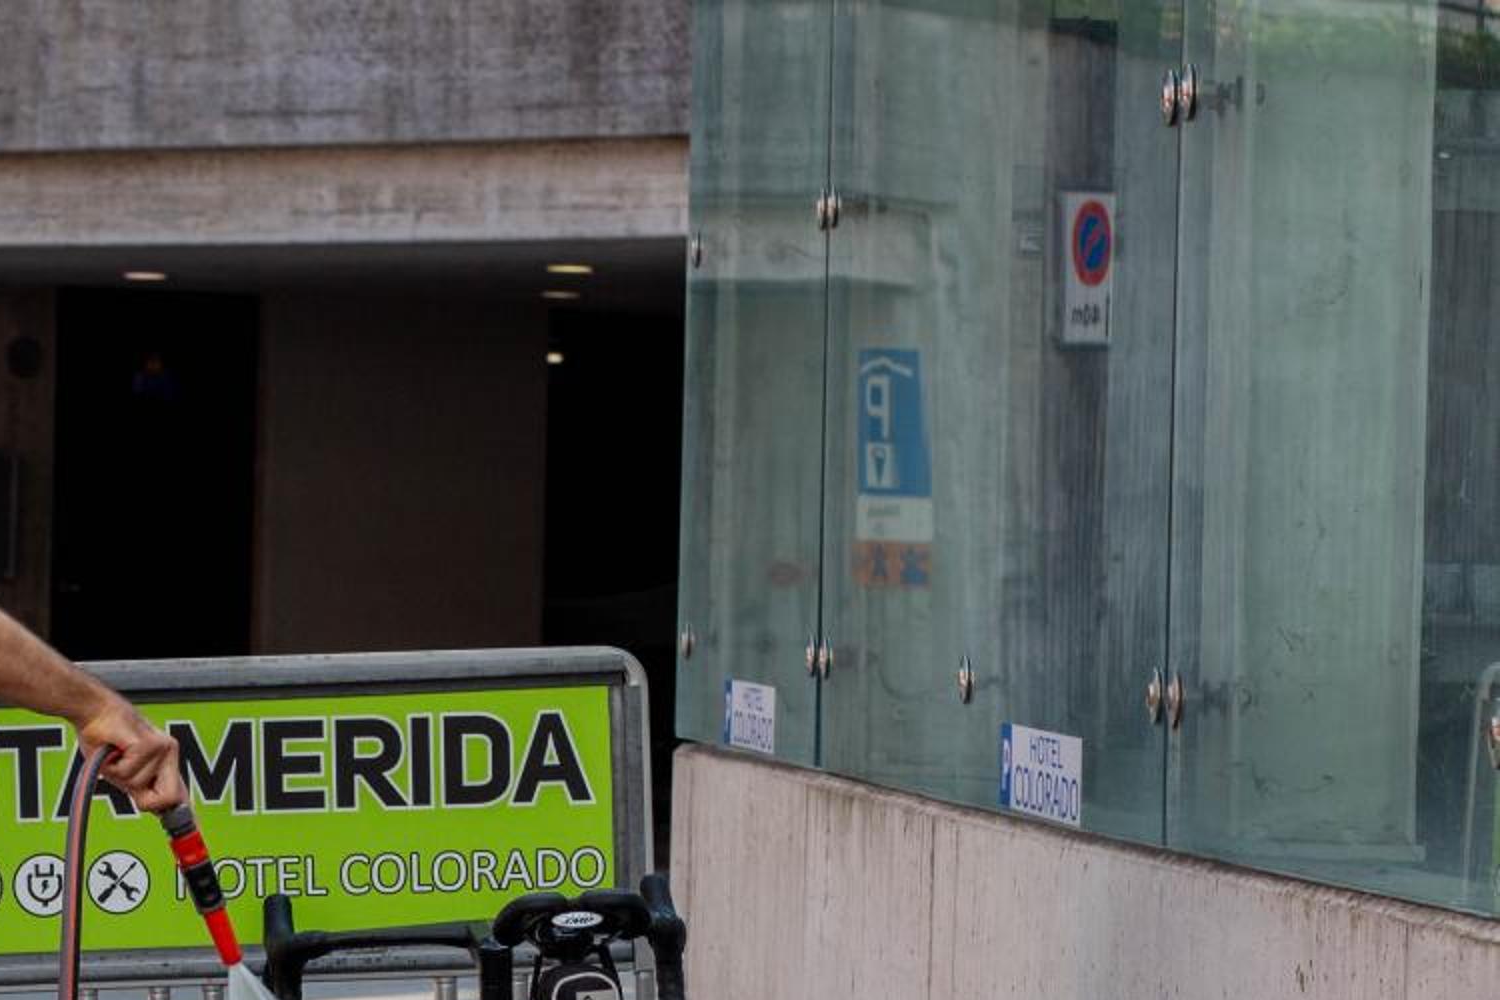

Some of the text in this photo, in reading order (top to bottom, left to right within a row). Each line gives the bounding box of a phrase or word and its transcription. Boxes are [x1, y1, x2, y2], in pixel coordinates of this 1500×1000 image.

[165, 709, 596, 815] MERIDA
[1029, 736, 1063, 769] HOTEL
[1014, 765, 1078, 820] COLORADO
[340, 847, 606, 896] COLORADO
